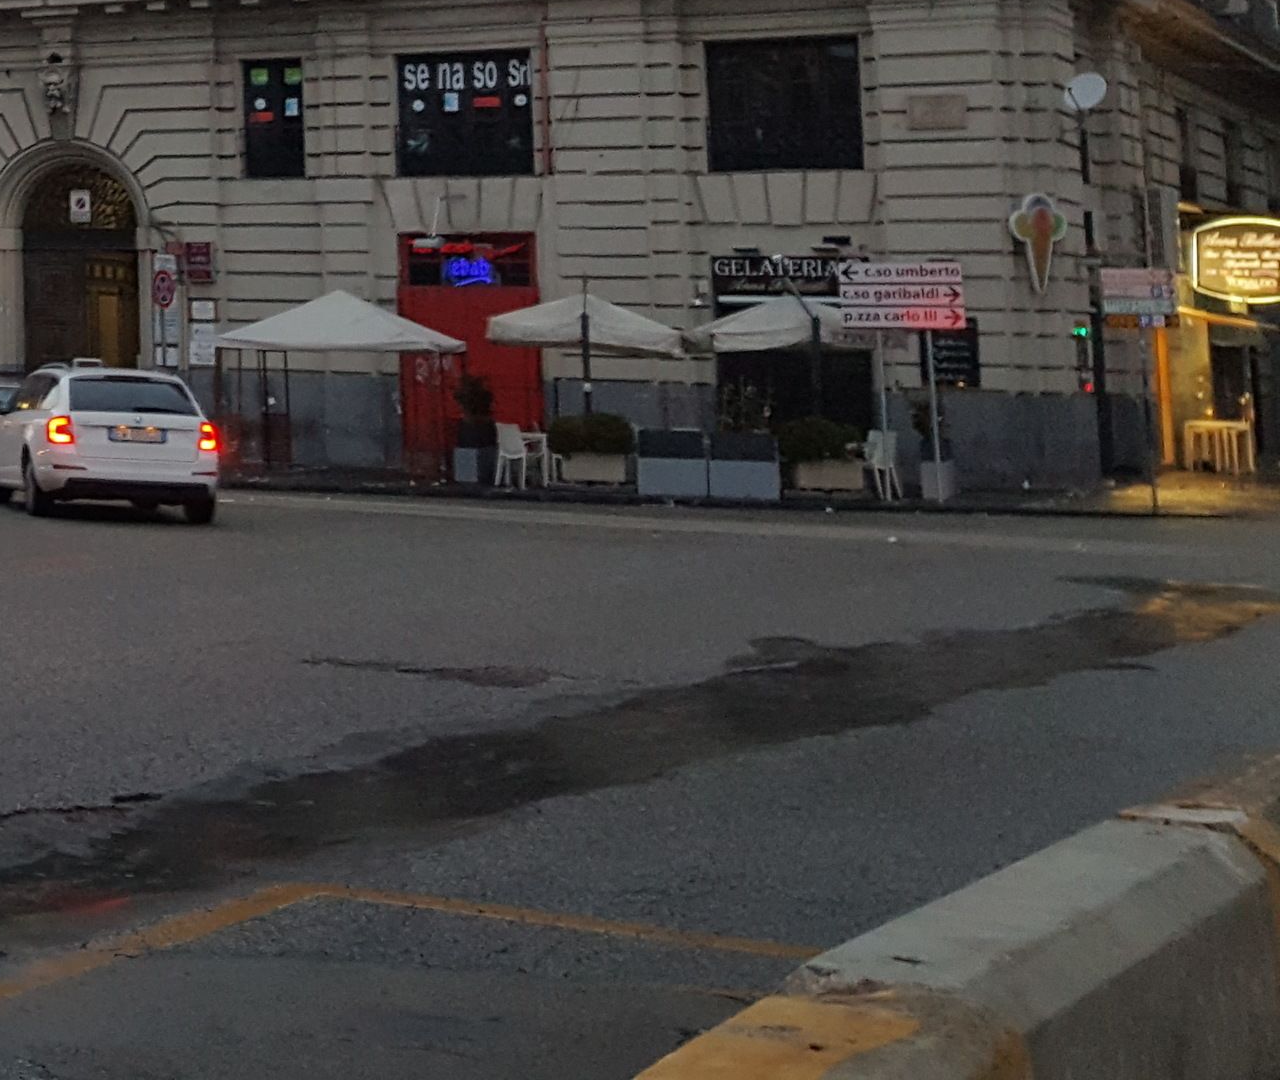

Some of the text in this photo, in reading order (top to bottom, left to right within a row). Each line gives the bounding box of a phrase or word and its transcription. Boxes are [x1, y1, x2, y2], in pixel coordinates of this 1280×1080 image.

[403, 63, 430, 90] se
[438, 62, 465, 90] na
[473, 60, 498, 88] so
[714, 258, 840, 278] GELATERIA
[864, 265, 960, 278] c.so umberto
[842, 287, 939, 302] c.so garibaldi
[844, 311, 880, 323] p.zza
[884, 310, 921, 322] carlo
